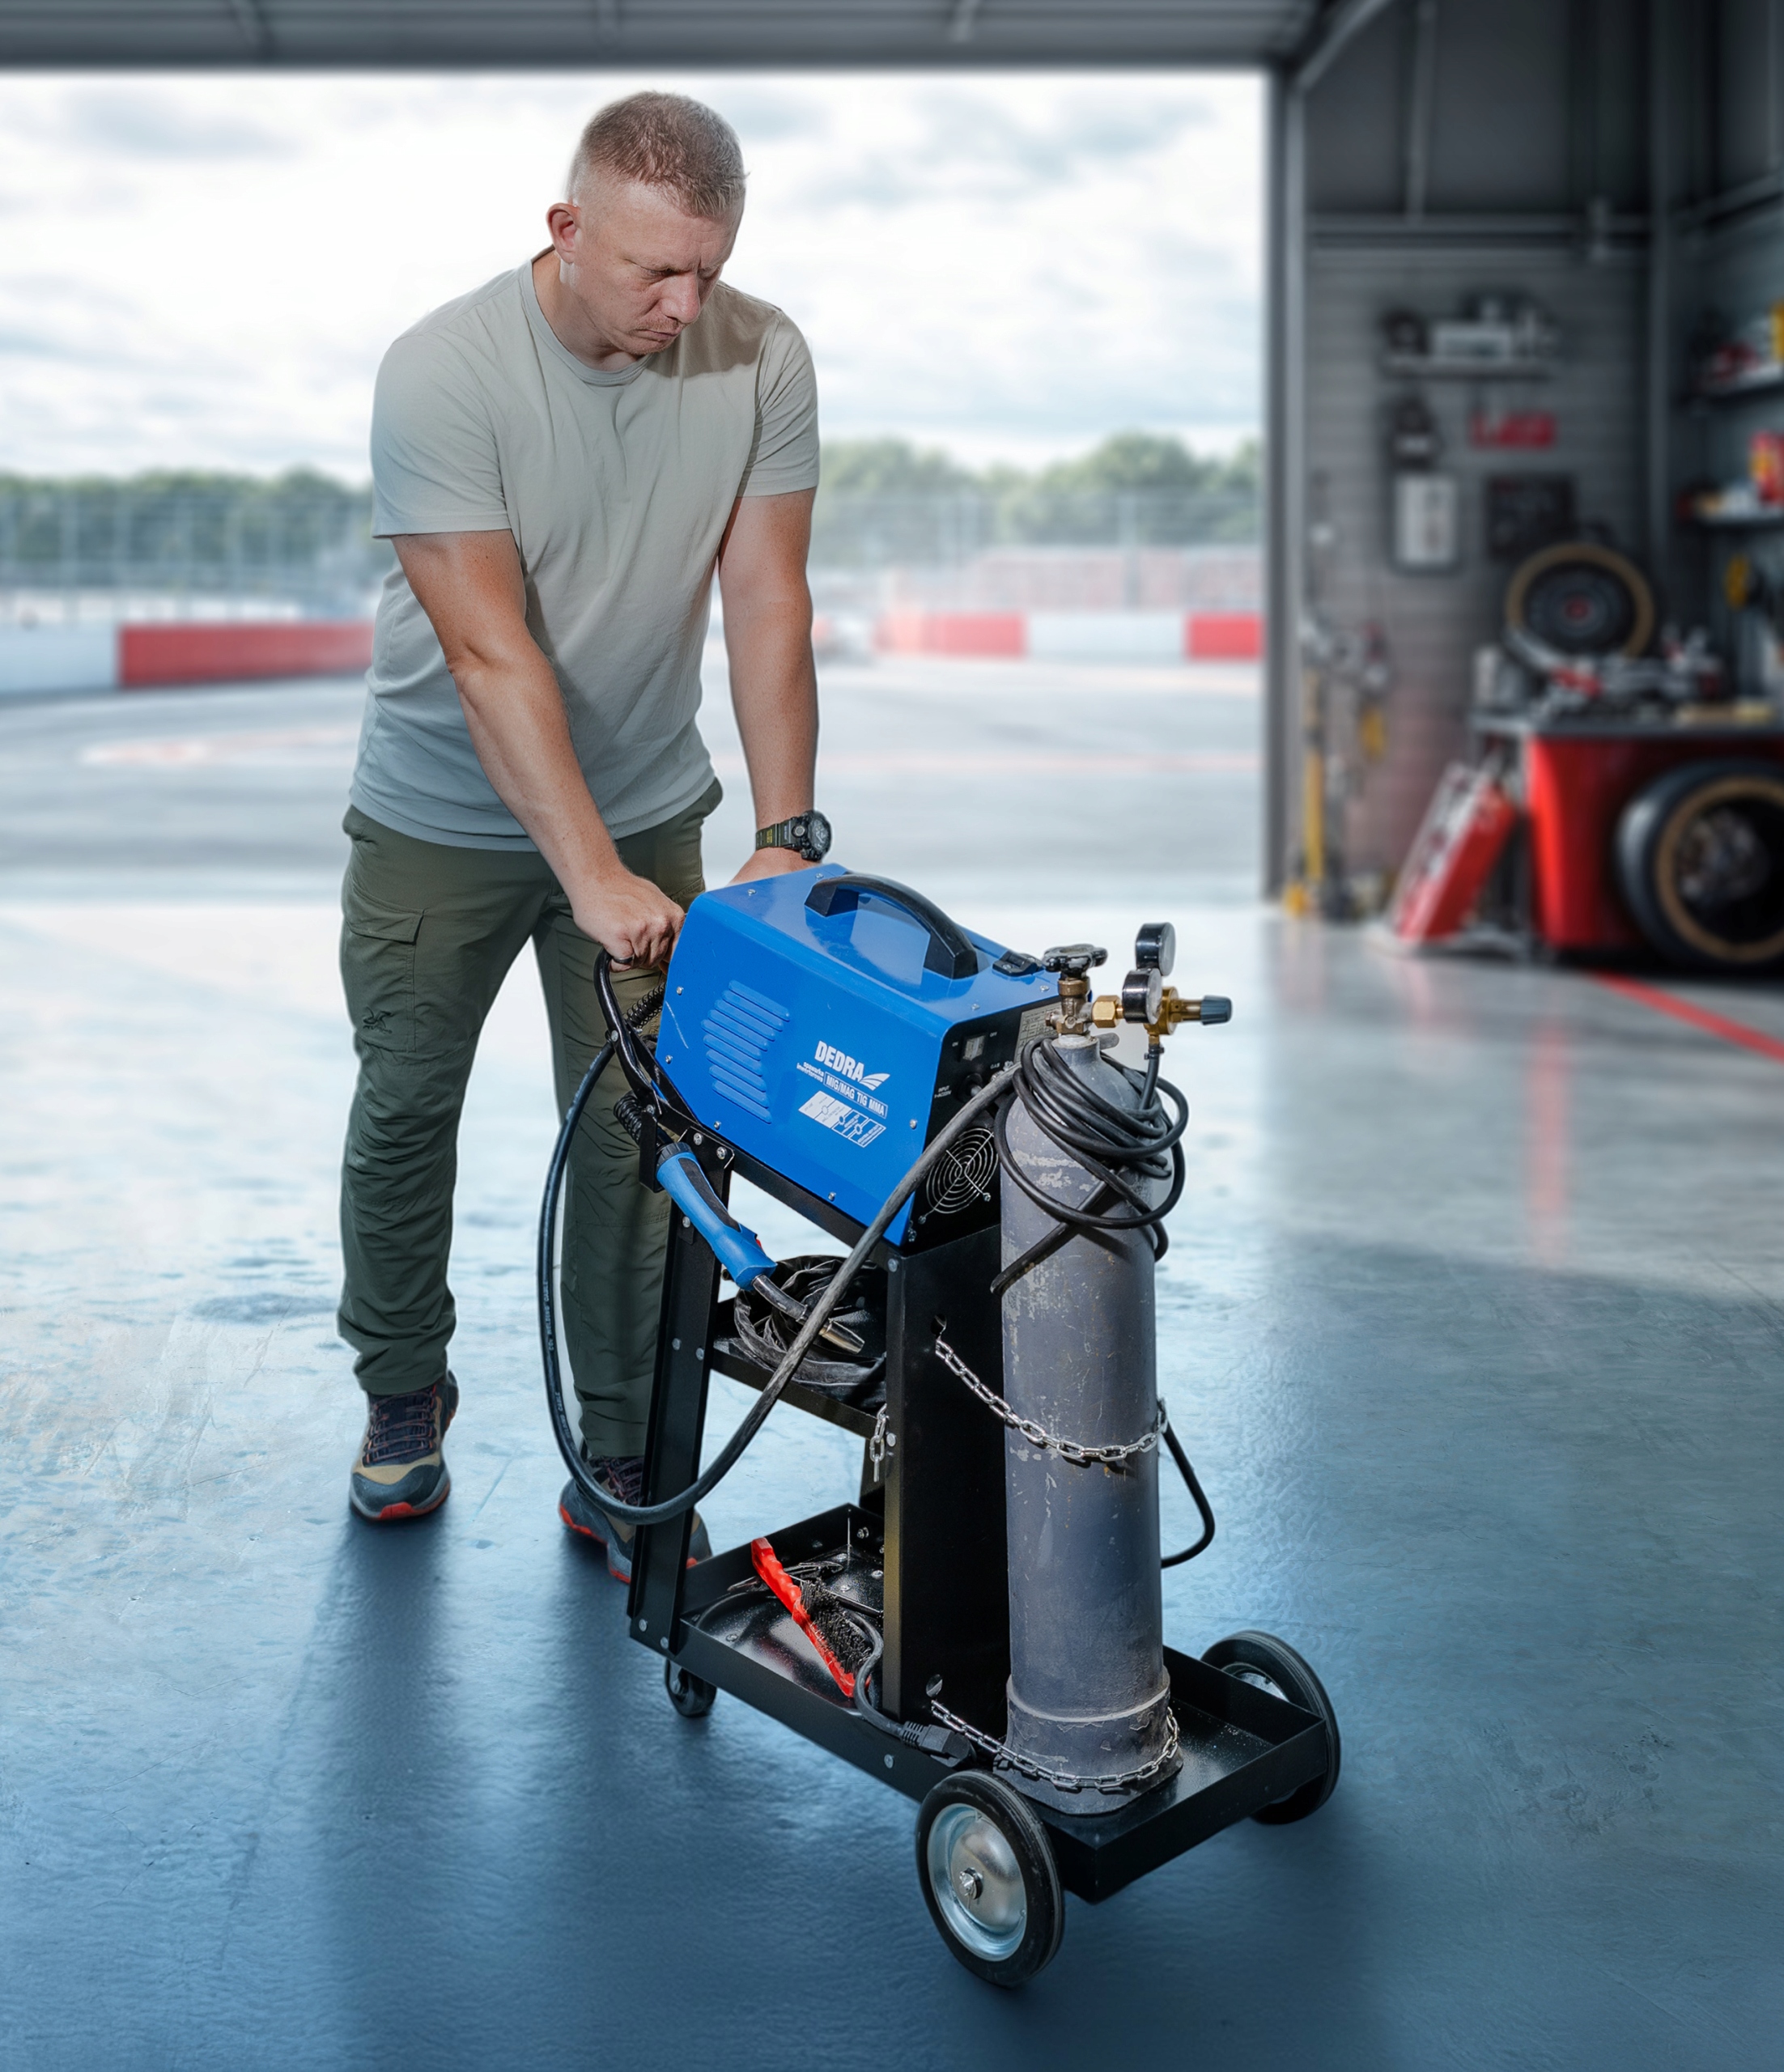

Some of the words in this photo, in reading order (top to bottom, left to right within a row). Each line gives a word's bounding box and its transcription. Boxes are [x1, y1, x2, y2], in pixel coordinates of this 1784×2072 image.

[814, 1040, 864, 1082] DEDRA
[826, 1075, 856, 1100] MIG/MAG
[856, 1091, 868, 1106] TIG
[869, 1098, 885, 1116] MMA
